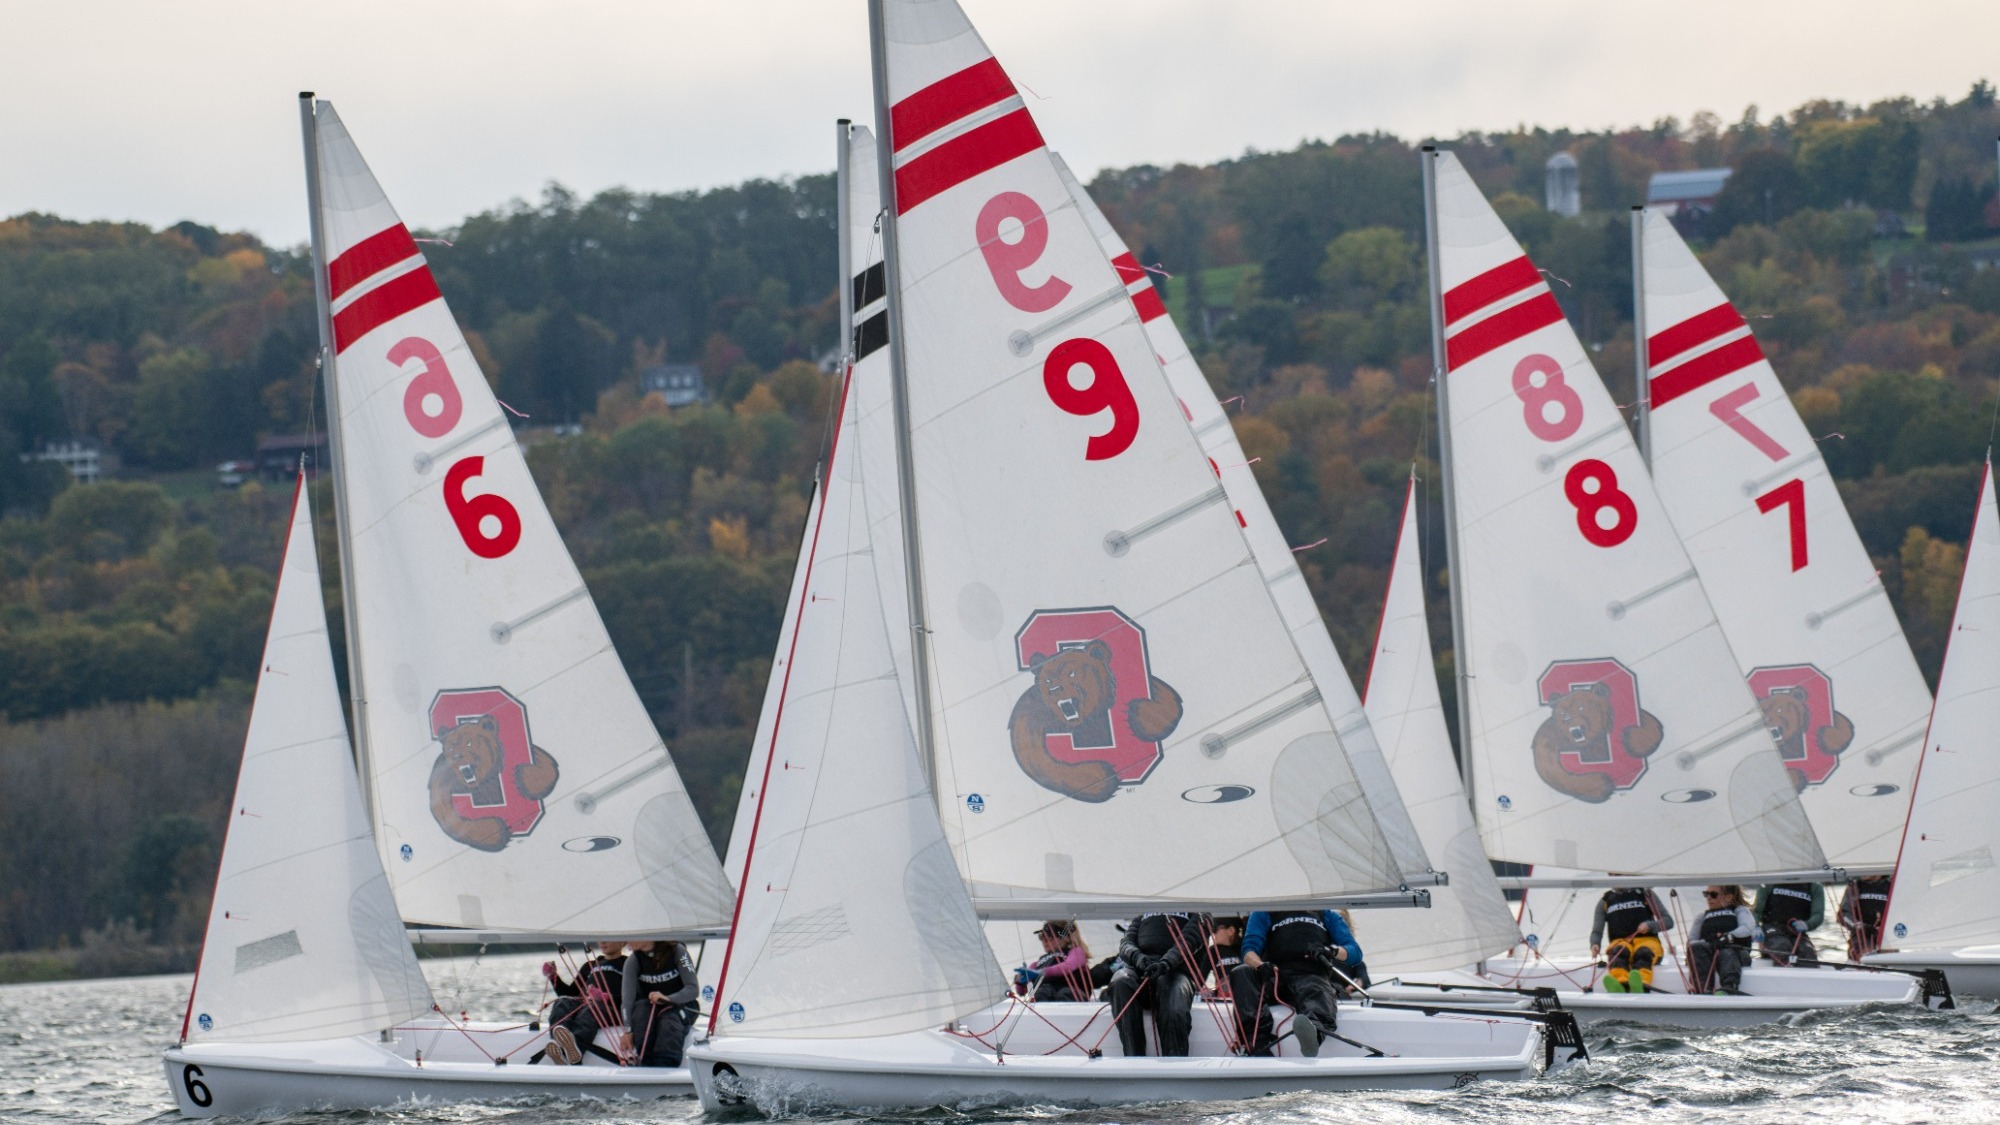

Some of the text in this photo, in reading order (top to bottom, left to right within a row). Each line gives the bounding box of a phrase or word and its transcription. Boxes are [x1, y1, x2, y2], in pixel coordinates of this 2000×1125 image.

[1043, 337, 1140, 461] 9
[443, 455, 522, 560] 6
[1564, 458, 1638, 548] 8
[1755, 478, 1808, 573] 7
[1773, 887, 1812, 902] CORNELL
[1859, 893, 1888, 901] ORNEL
[183, 1063, 213, 1108] 6
